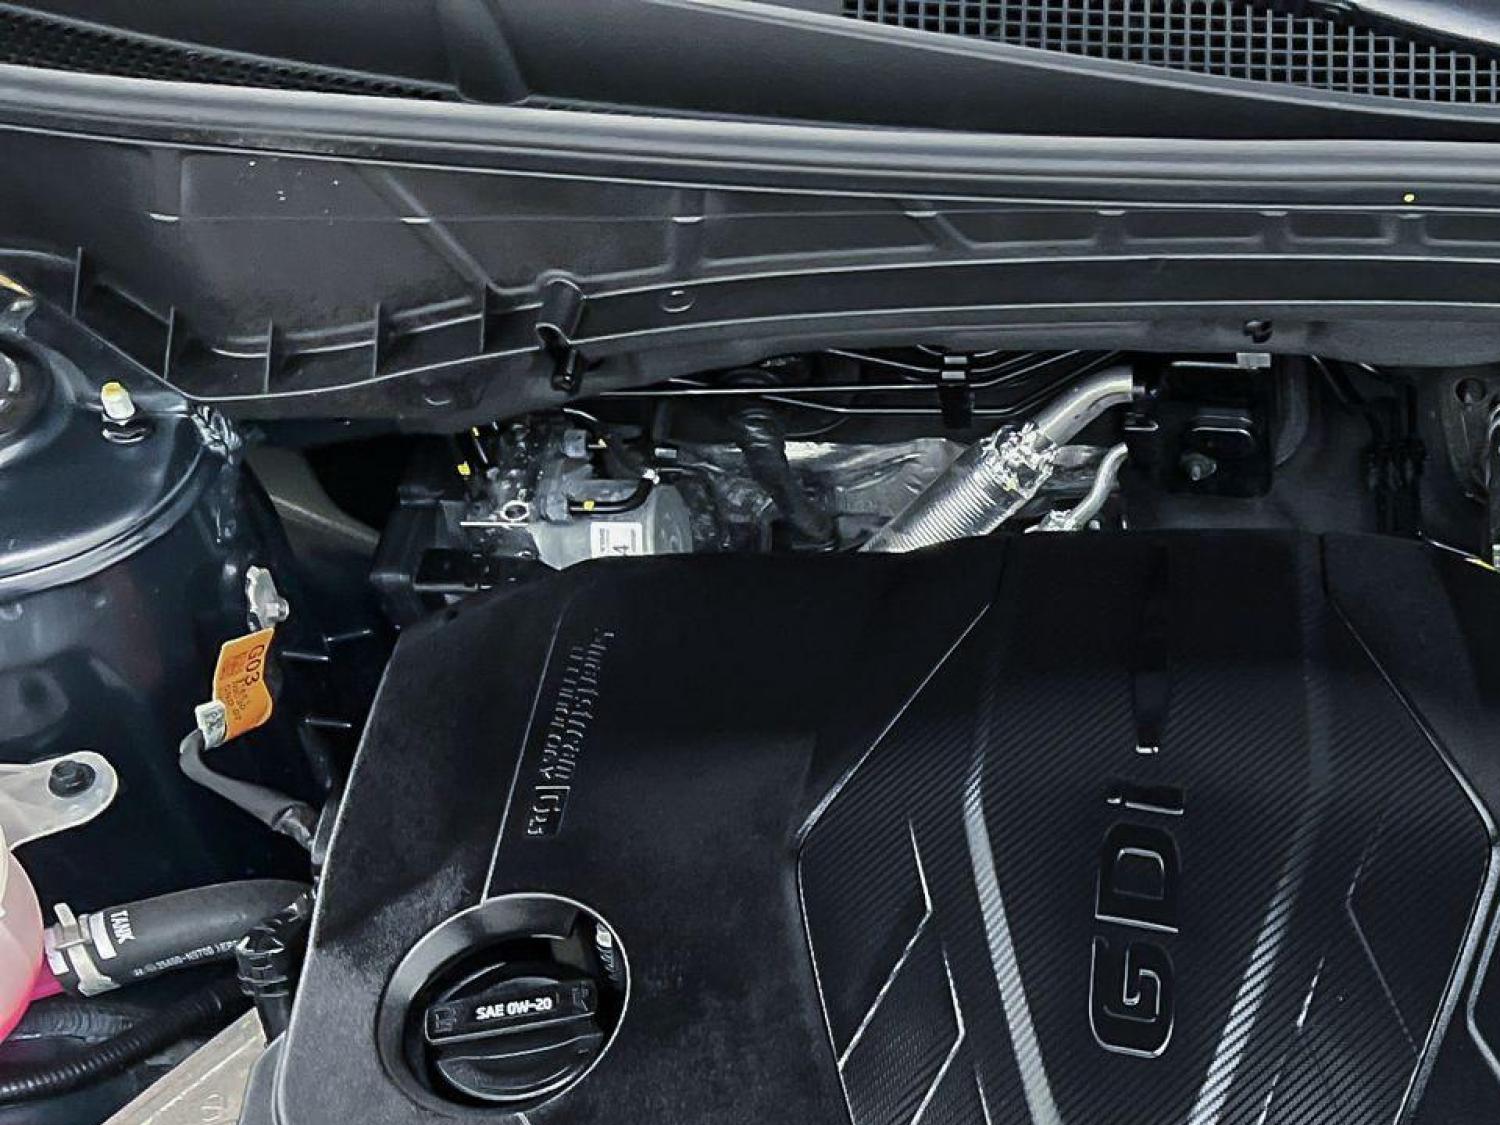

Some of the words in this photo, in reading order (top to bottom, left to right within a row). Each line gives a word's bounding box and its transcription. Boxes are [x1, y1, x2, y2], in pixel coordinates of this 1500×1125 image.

[243, 643, 266, 686] G03
[110, 910, 136, 945] TANK
[1087, 785, 1186, 1060] GDi
[475, 1003, 505, 1020] SAE
[506, 996, 553, 1015] 0W-20
